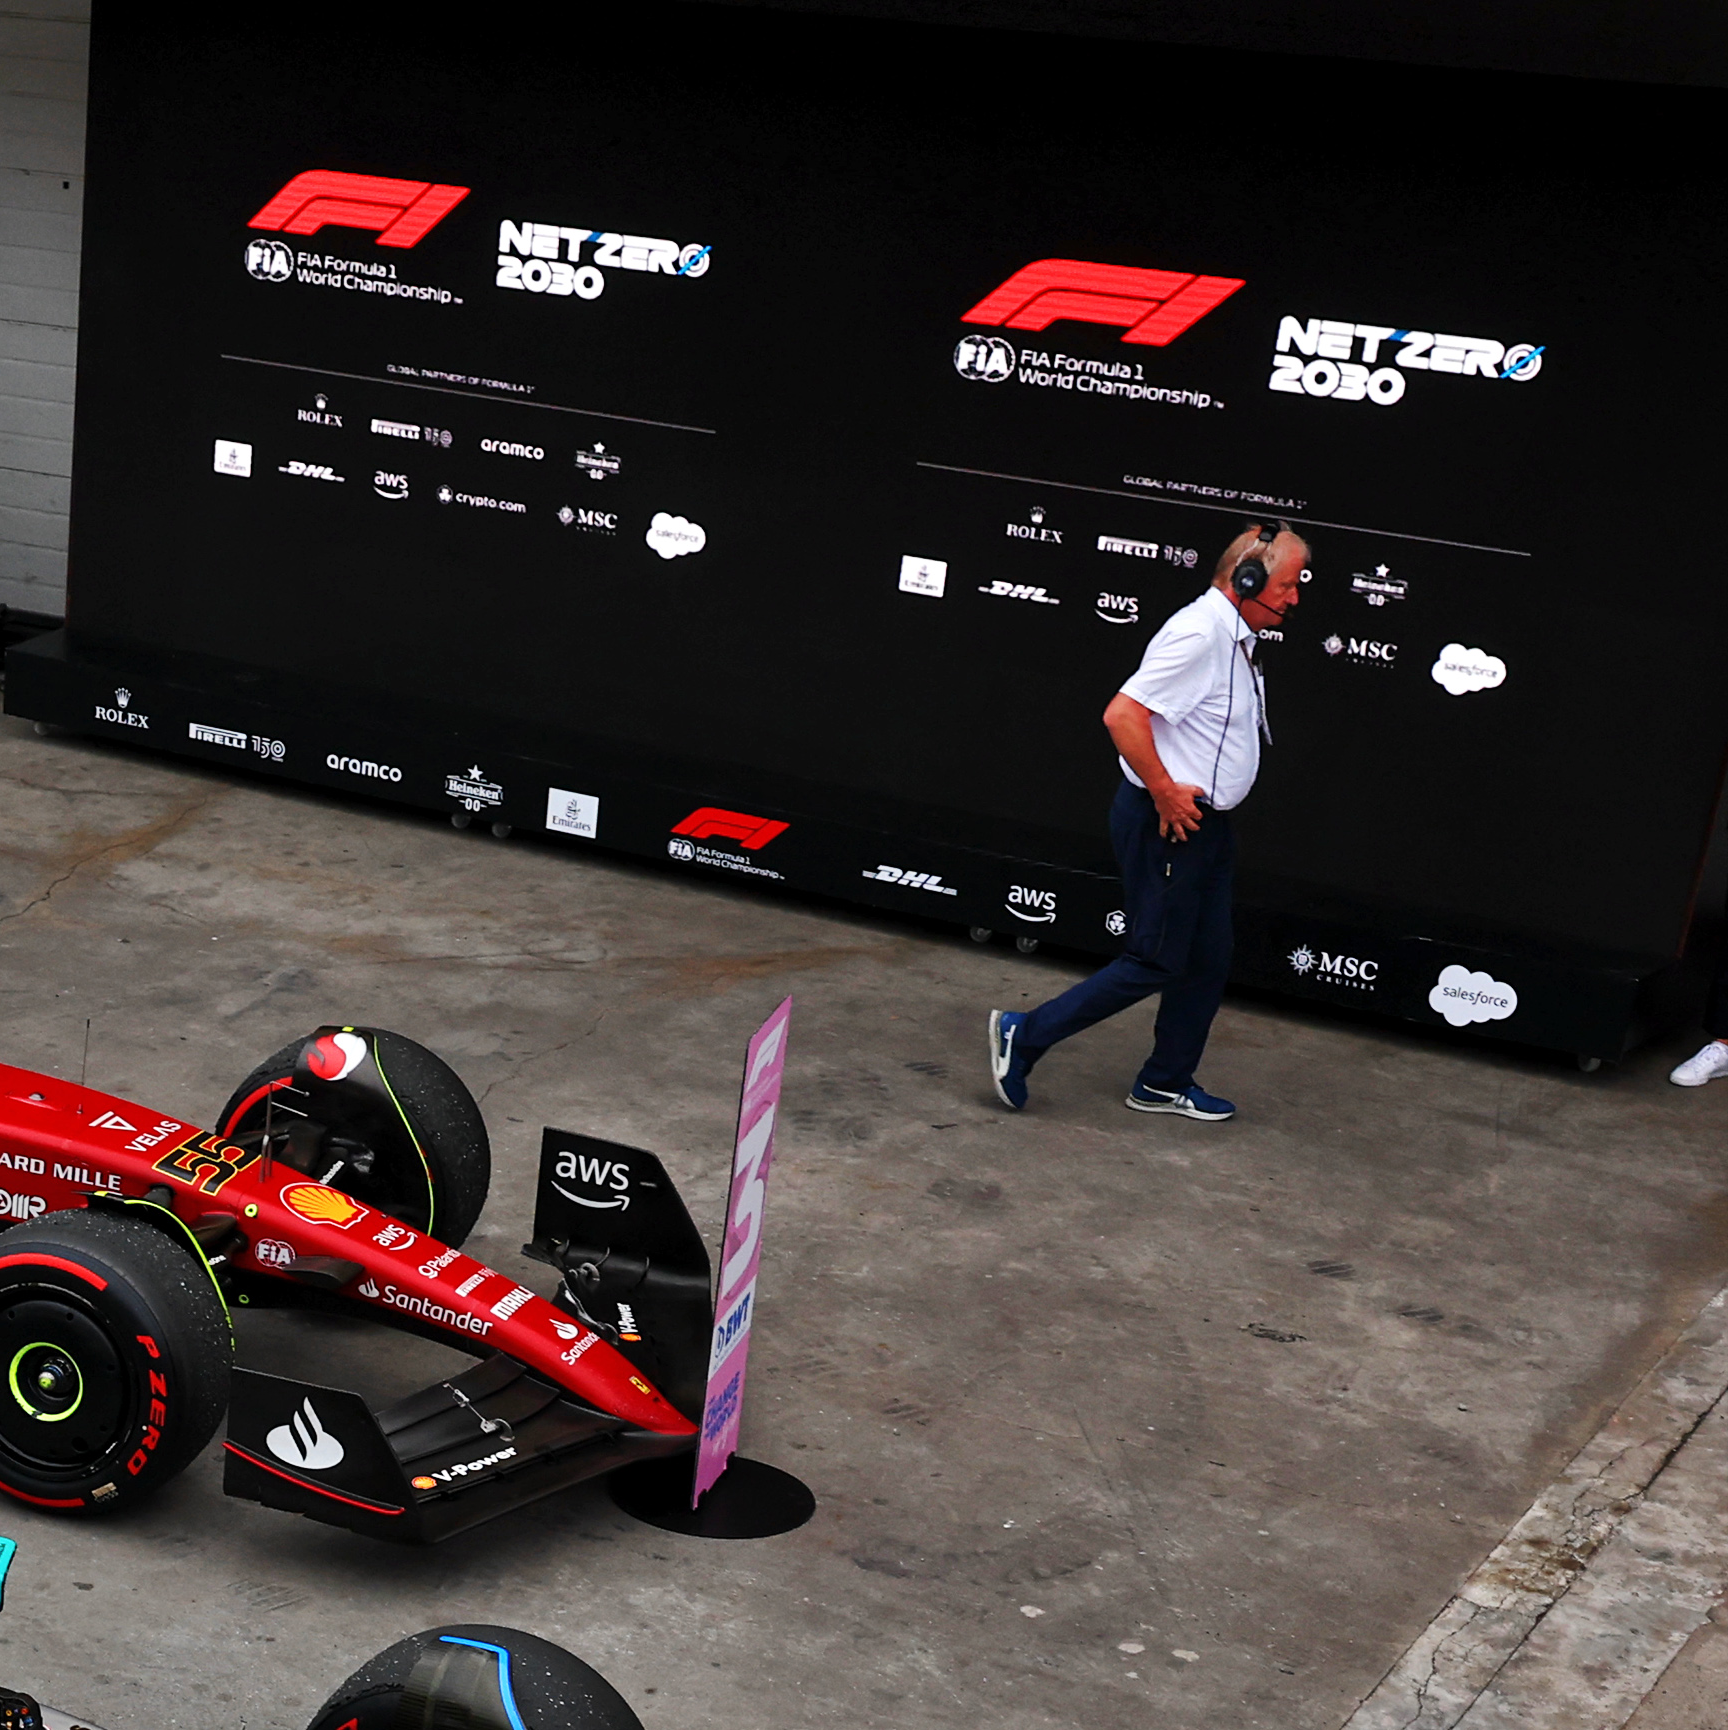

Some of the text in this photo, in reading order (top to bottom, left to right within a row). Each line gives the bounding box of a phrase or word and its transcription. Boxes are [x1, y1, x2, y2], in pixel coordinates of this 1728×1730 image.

[298, 252, 397, 278] FIA Formula 1
[496, 255, 604, 299] 2030
[297, 268, 451, 303] World Championship
[1021, 350, 1144, 380] FIA Formula 1
[1019, 366, 1212, 410] World Championship
[1269, 355, 1407, 406] 2030
[297, 409, 343, 428] ROLEX
[480, 438, 544, 461] aramco
[287, 461, 335, 481] DHL
[374, 470, 408, 489] aws
[455, 490, 527, 514] crypto.com
[576, 507, 618, 529] MSC
[1006, 523, 1063, 544] ROLEX
[990, 581, 1048, 602] DHL
[1097, 592, 1138, 614] aws
[1347, 637, 1398, 662] MSC
[95, 705, 149, 730] ROLEX
[189, 722, 247, 749] PIRELLI
[326, 753, 403, 782] aramco
[447, 778, 501, 800] Heineken
[551, 815, 592, 832] Emirates
[696, 846, 751, 864] FIA Formula 1
[696, 854, 779, 880] World Championship
[874, 865, 947, 893] DHL
[1008, 885, 1057, 911] aws
[1318, 951, 1379, 981] MSC
[1316, 974, 1375, 991] CRUISES
[1443, 986, 1508, 1008] salesforce
[125, 1120, 181, 1152] VELAS
[152, 1130, 262, 1196] 55
[556, 1150, 629, 1191] aws
[53, 1164, 121, 1191] MILLE
[722, 1102, 775, 1300] 3
[382, 1285, 493, 1337] Santander
[127, 1335, 171, 1476] P ZERO
[430, 1446, 518, 1485] V-Power
